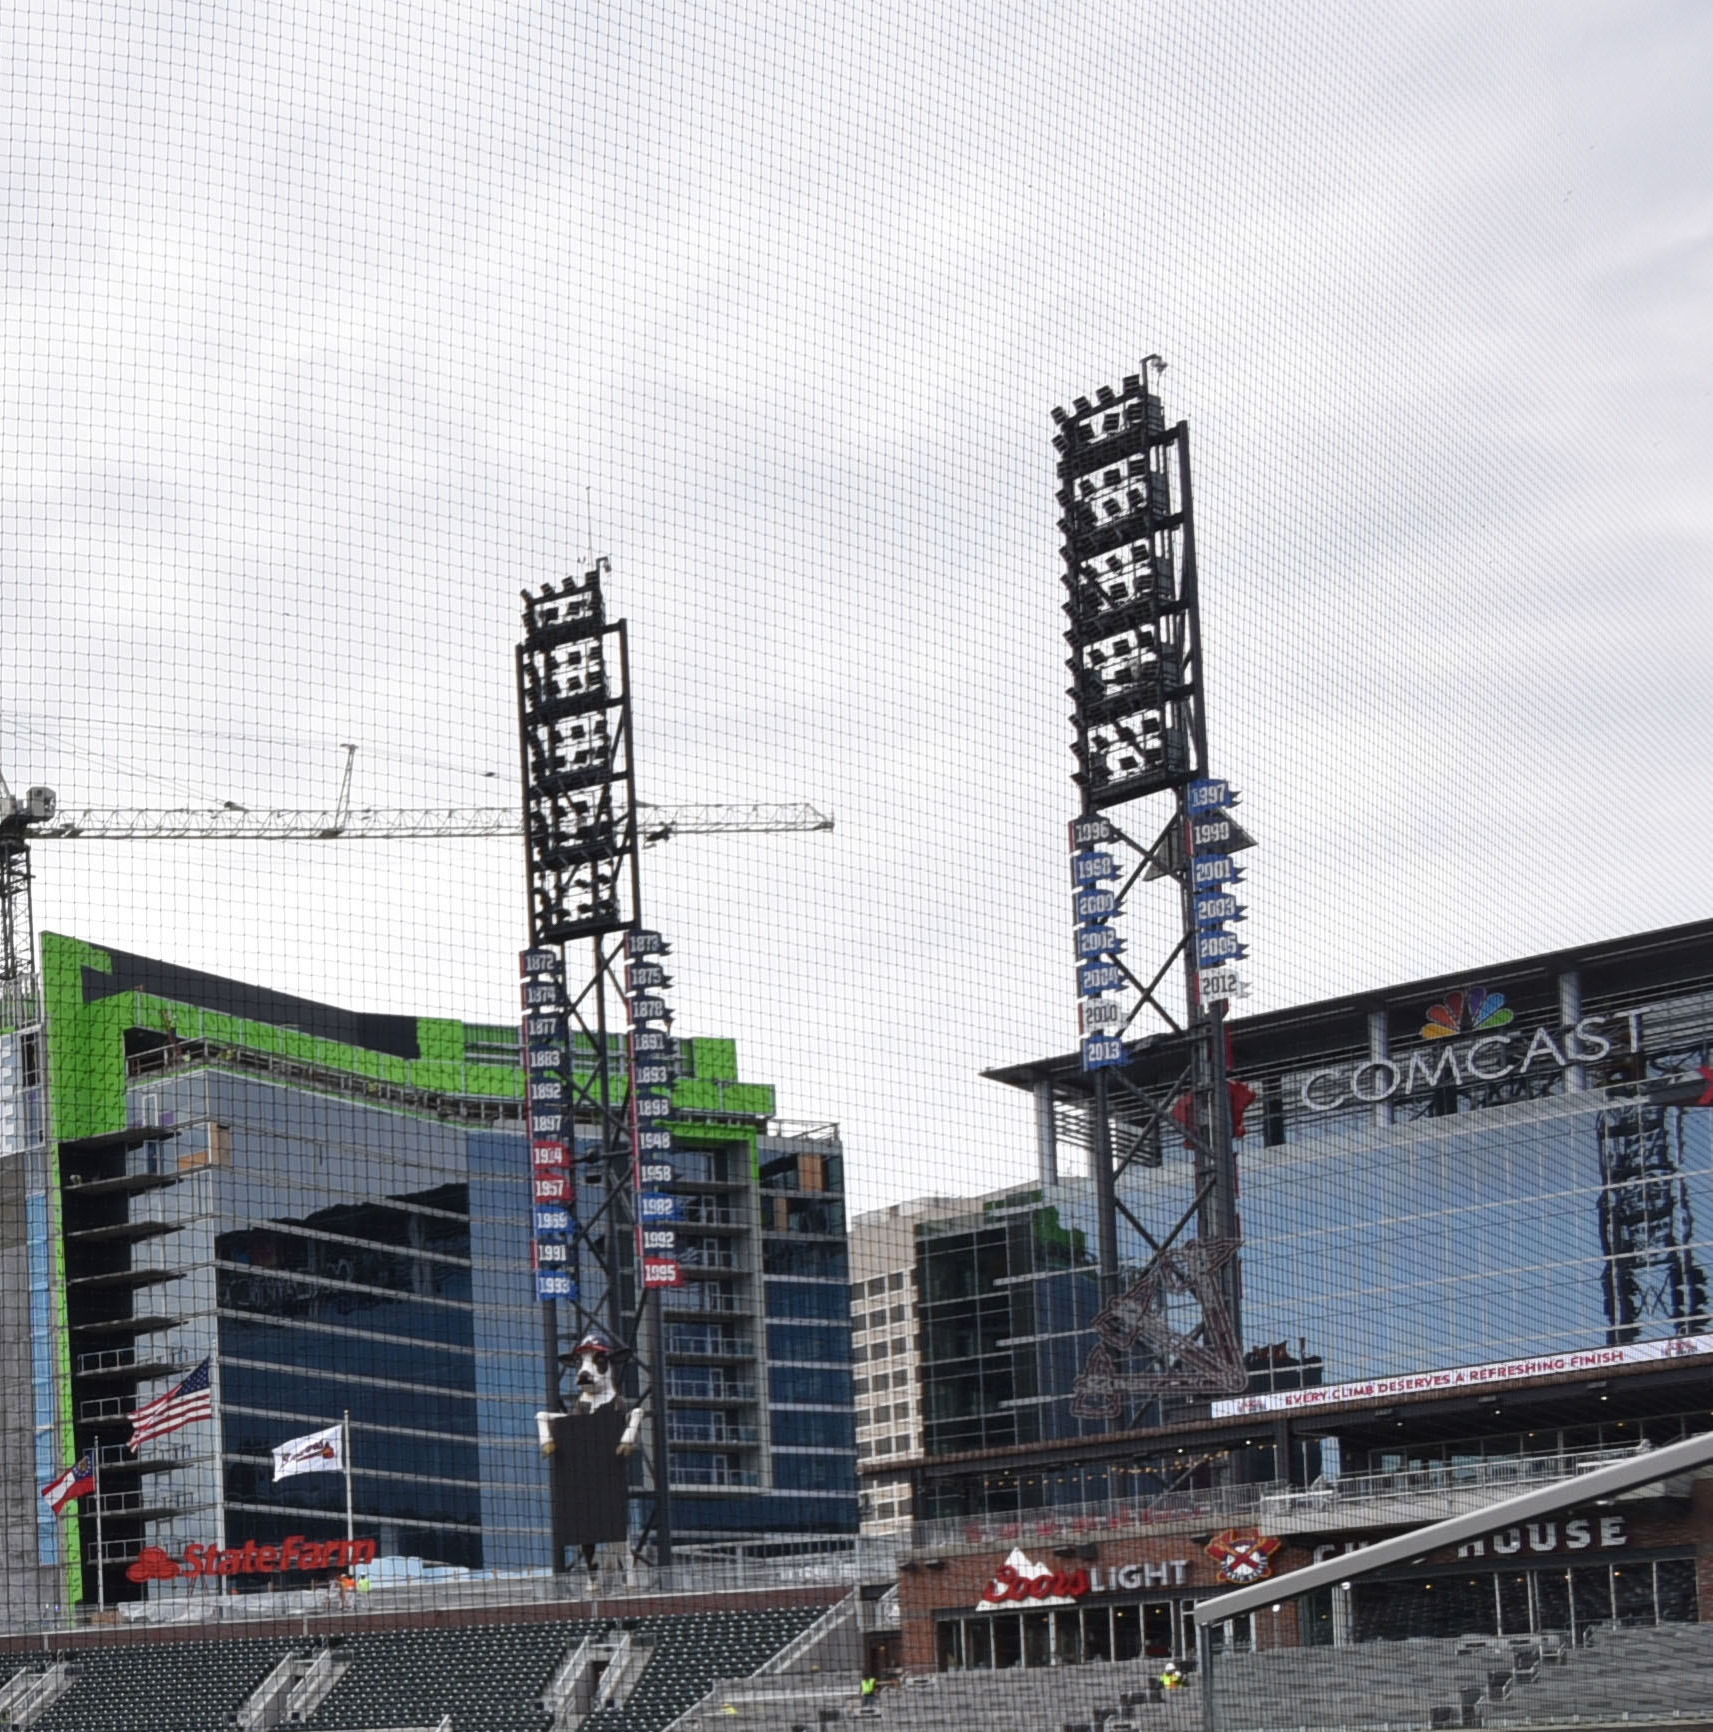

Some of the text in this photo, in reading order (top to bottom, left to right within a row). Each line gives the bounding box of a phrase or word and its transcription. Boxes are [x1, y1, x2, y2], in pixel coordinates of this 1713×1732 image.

[1192, 783, 1225, 807] 1997
[1076, 820, 1109, 842] 1996
[1194, 822, 1230, 845] 1999
[1078, 857, 1112, 880] 1998
[1196, 860, 1231, 882] 2001
[1080, 894, 1114, 916] 2000
[1198, 899, 1235, 919] 2003
[1081, 930, 1115, 951] 2002
[1200, 935, 1237, 957] 2005
[526, 954, 554, 970] 1872
[631, 968, 662, 984] 1875
[1083, 967, 1119, 989] 2004
[1202, 974, 1237, 995] 2012
[1086, 1004, 1118, 1025] 2010
[529, 1019, 556, 1035] 1877
[530, 1051, 560, 1067] 1883
[1088, 1041, 1120, 1061] 2013
[1302, 1007, 1651, 1110] COMCAST
[636, 1066, 667, 1083] 1893
[531, 1083, 562, 1099] 1892
[533, 1116, 562, 1132] 1897
[639, 1133, 670, 1150] 1948
[641, 1165, 672, 1182] 1958
[642, 1198, 673, 1215] 1982
[644, 1231, 674, 1248] 1992
[538, 1245, 567, 1261] 1991
[1285, 1390, 1327, 1406] EVERY
[1331, 1384, 1374, 1400] CLIMB
[1378, 1373, 1451, 1393] DESERVES
[1455, 1371, 1465, 1383] A
[1469, 1358, 1565, 1381] REFRESHING
[1570, 1349, 1624, 1368] FINISH
[982, 1564, 1090, 1603] Coors
[1090, 1559, 1193, 1592] LIGHT
